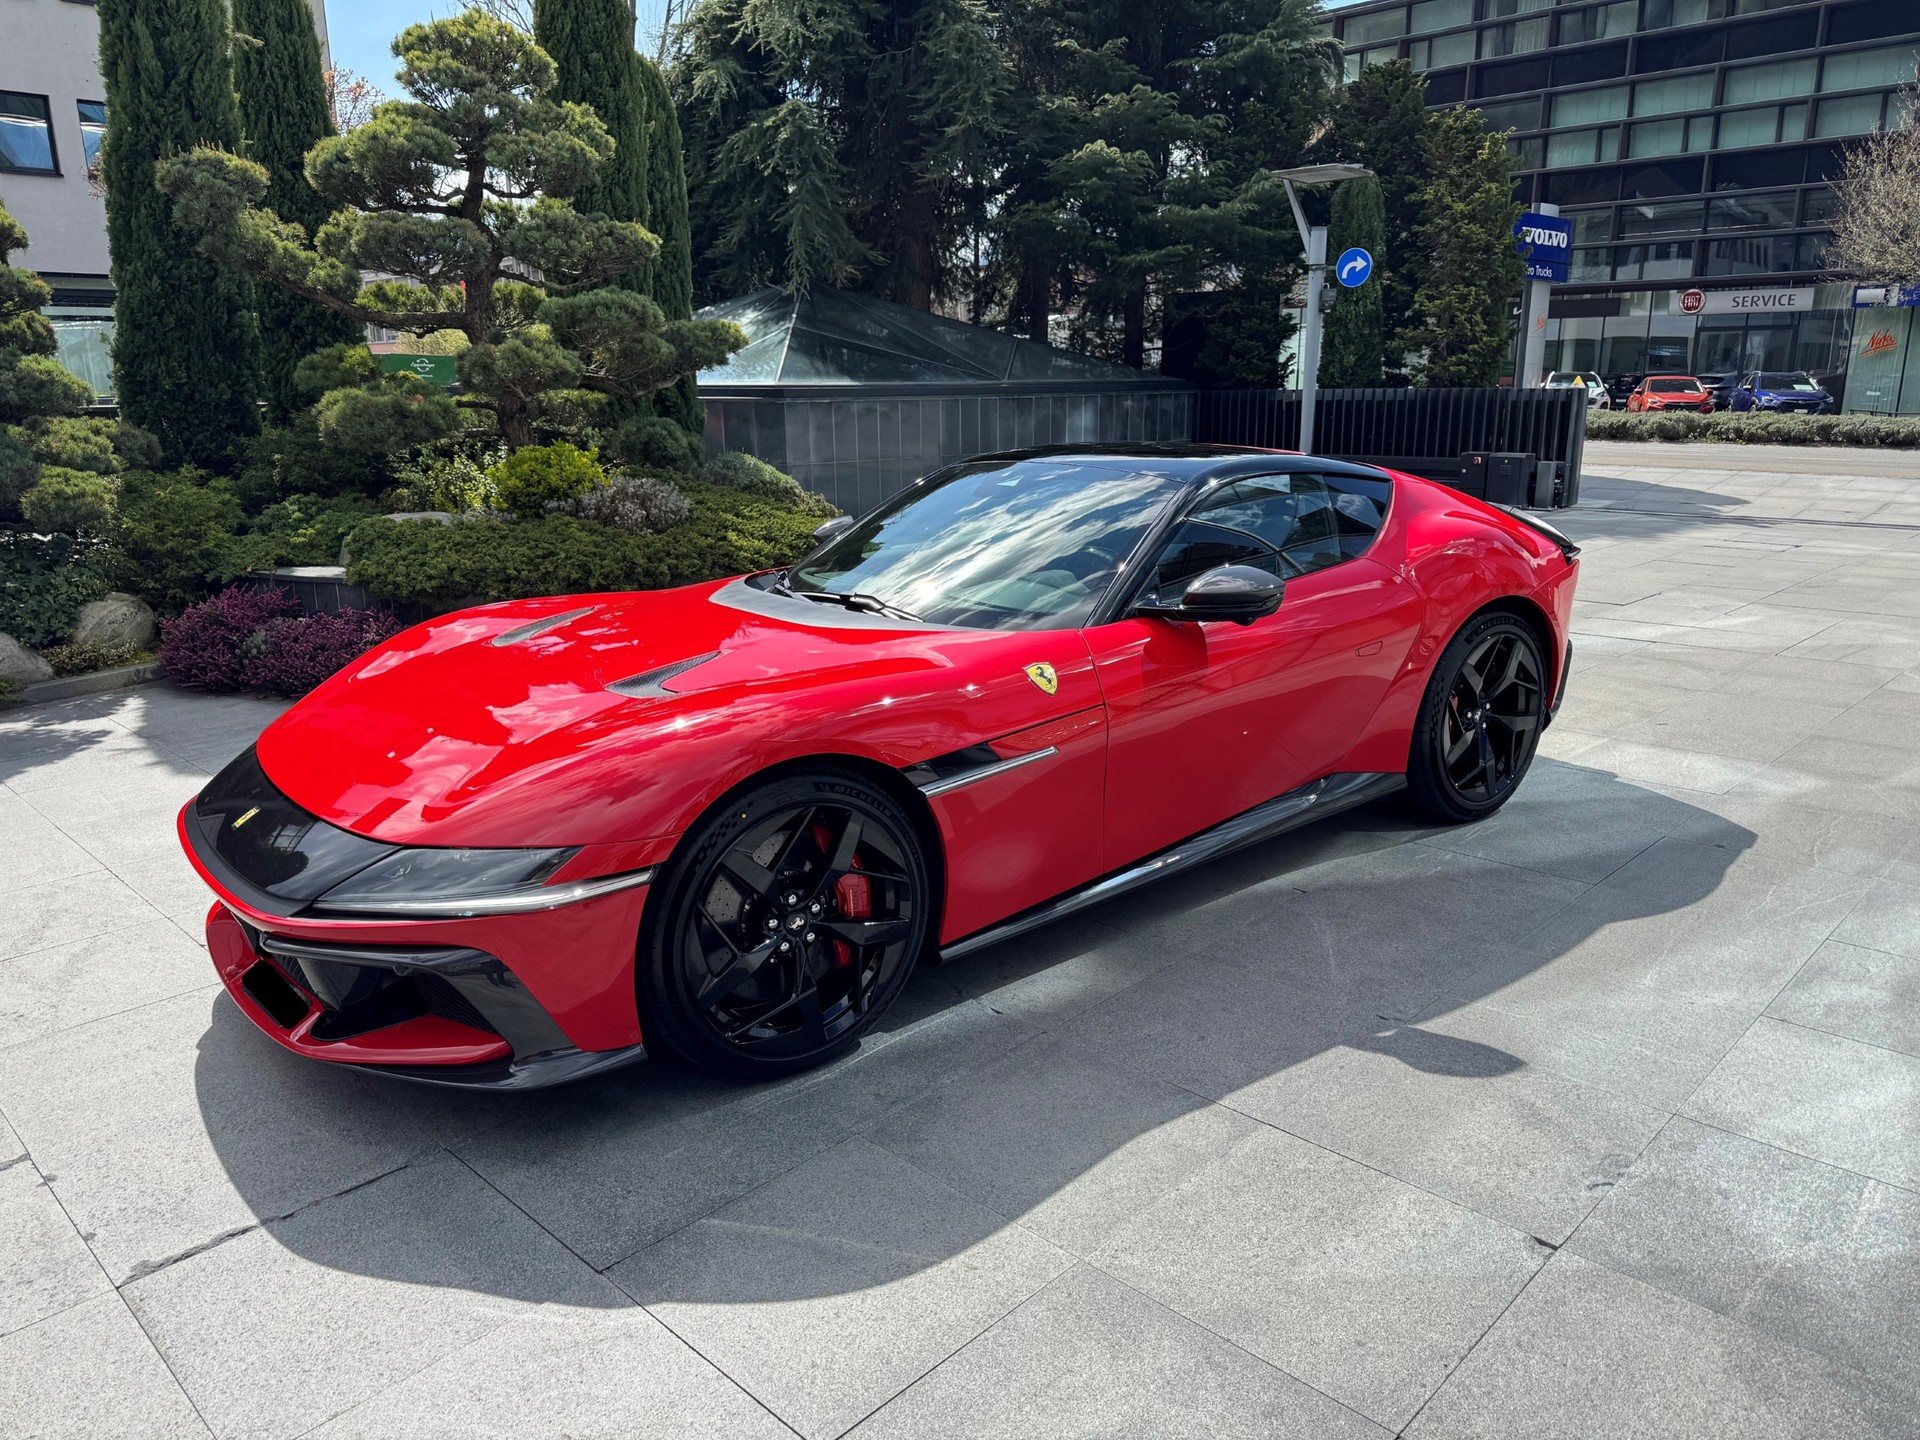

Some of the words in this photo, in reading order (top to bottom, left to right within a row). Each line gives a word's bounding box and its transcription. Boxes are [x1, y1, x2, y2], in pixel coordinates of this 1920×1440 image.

[1522, 226, 1568, 249] VOLVO
[1535, 264, 1553, 278] Trucks
[1684, 295, 1700, 308] FIAT
[1731, 293, 1797, 308] SERVICE
[834, 784, 893, 817] MICHELIN
